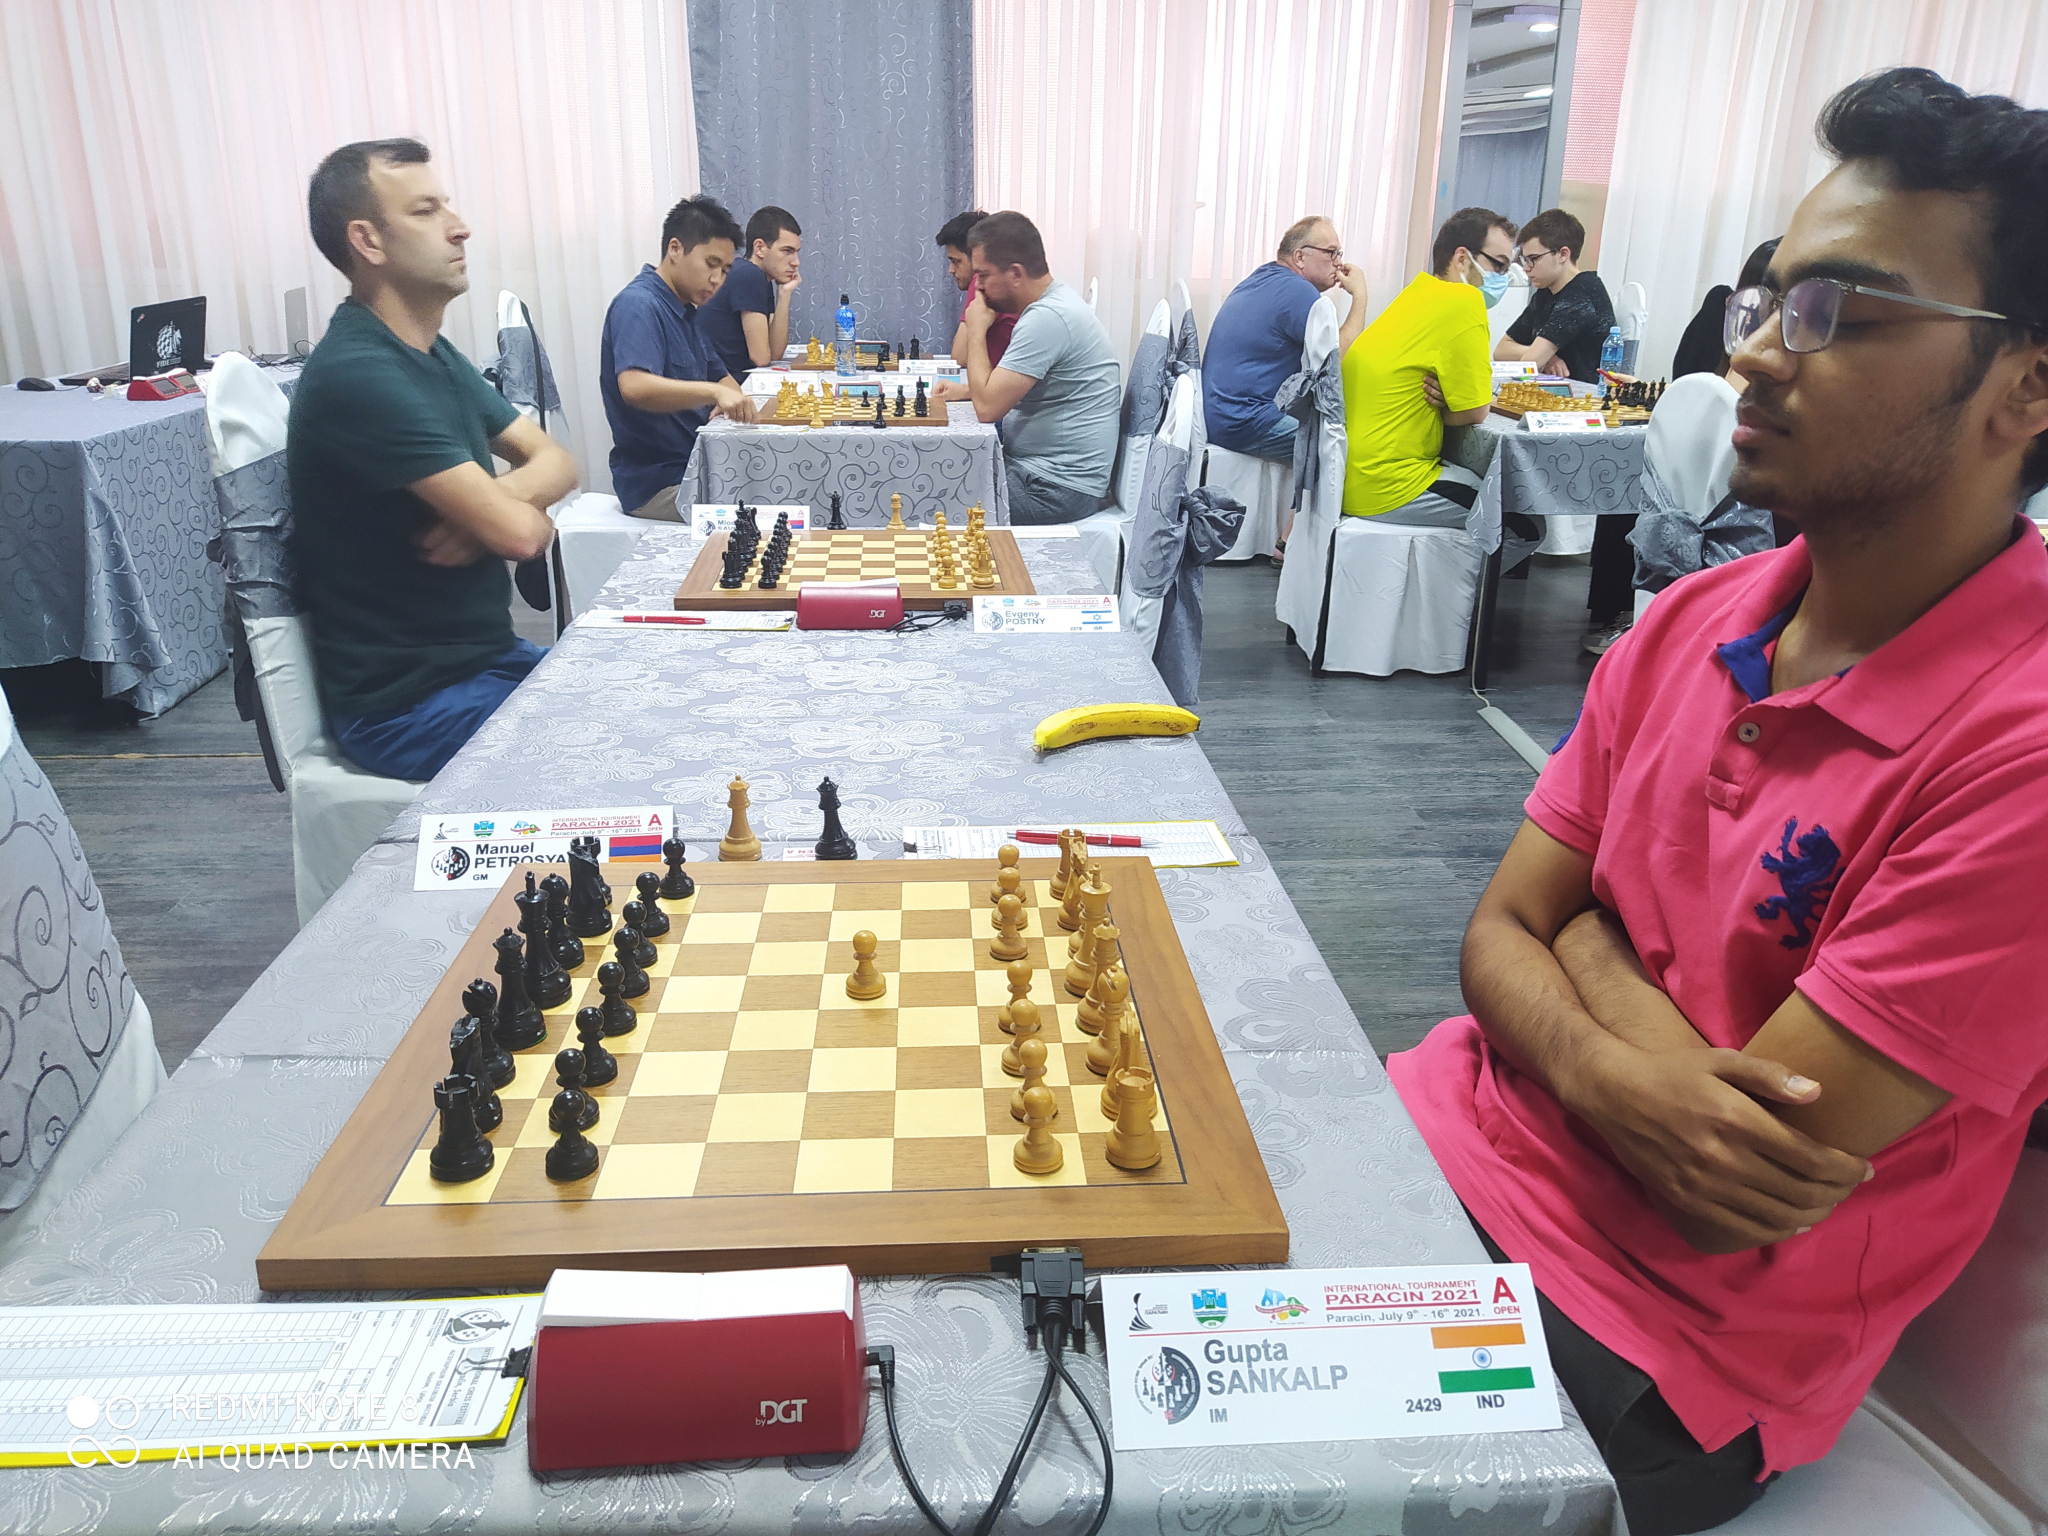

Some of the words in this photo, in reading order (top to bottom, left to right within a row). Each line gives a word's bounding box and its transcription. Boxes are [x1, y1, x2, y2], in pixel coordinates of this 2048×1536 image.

[156, 360, 170, 368] FIDE
[870, 610, 886, 618] DGT
[648, 814, 662, 826] A
[476, 842, 534, 855] Manuel
[474, 854, 566, 868] PETROSYA
[1324, 1283, 1404, 1293] INTERNATIONAL
[1407, 1280, 1476, 1290] TOURNAMENT
[1493, 1276, 1517, 1304] A
[1326, 1291, 1429, 1305] PARACIN
[1431, 1289, 1478, 1301] 2021
[1326, 1313, 1375, 1323] Paracin,
[1379, 1310, 1403, 1322] July
[1454, 1308, 1485, 1318] 2021.
[1493, 1305, 1520, 1315] OPEN
[1204, 1338, 1288, 1369] Gupta
[1207, 1365, 1348, 1396] SANKALP
[1405, 1398, 1442, 1413] 2429
[1476, 1394, 1505, 1408] IND
[760, 1399, 808, 1425] DGT
[1209, 1408, 1228, 1423] IM
[756, 1417, 766, 1427] by
